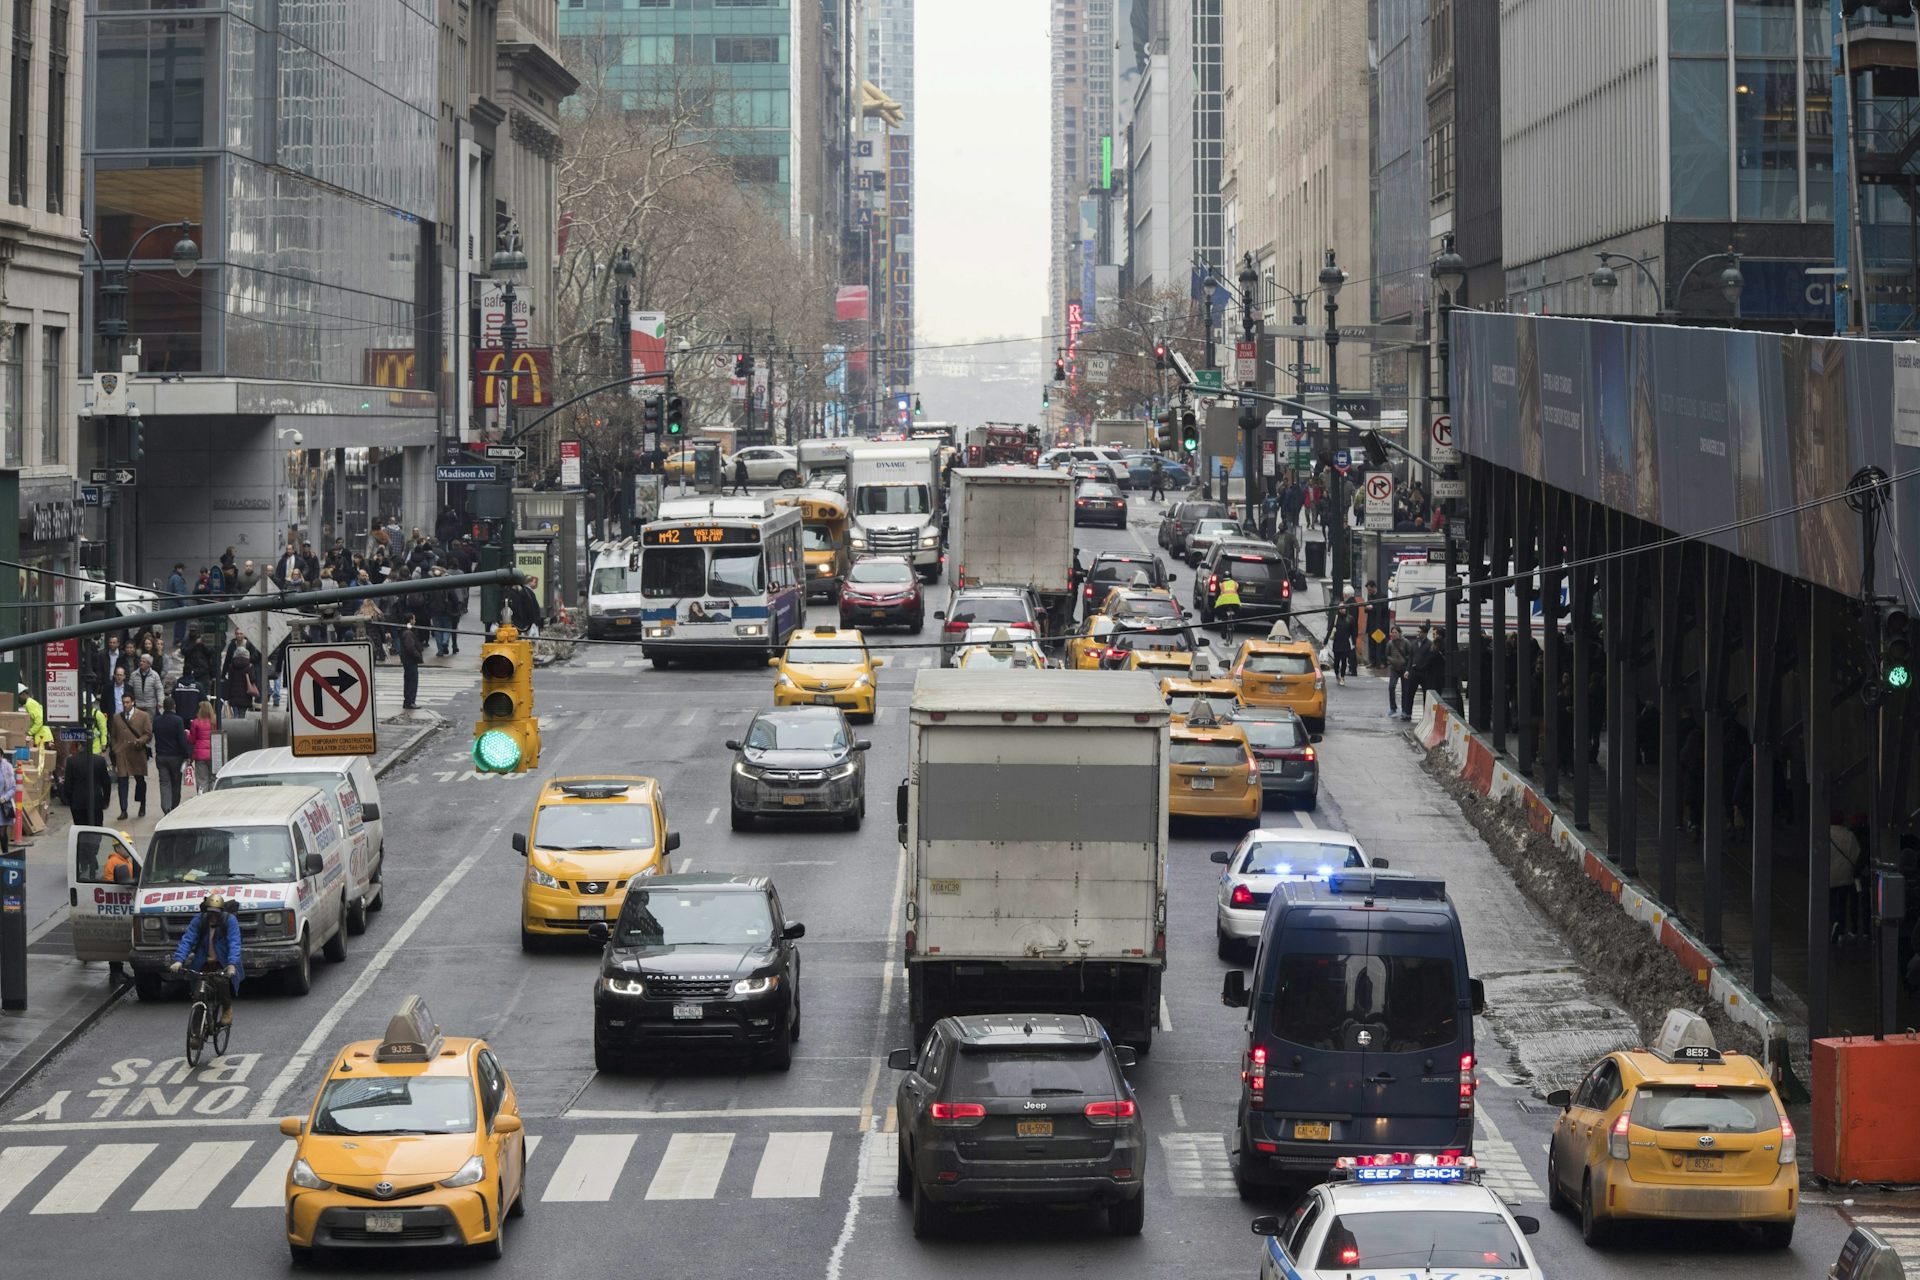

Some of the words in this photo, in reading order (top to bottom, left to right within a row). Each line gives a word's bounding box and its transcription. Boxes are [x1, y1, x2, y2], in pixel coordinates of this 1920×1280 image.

[486, 313, 505, 349] etro
[1092, 361, 1104, 369] NO
[508, 449, 521, 457] WAY
[439, 469, 475, 479] Madison
[478, 469, 494, 478] Ave
[659, 530, 680, 542] M42
[519, 556, 542, 565] REBAG
[48, 671, 55, 681] 3
[9, 870, 18, 884] P
[97, 905, 135, 915] PREVE
[391, 1045, 412, 1053] 9J35
[1686, 1048, 1709, 1057] 8E52
[98, 1053, 263, 1086] BUS
[13, 1085, 251, 1121] ONLY
[1023, 1101, 1047, 1110] Jeep
[1413, 1168, 1461, 1178] BACK
